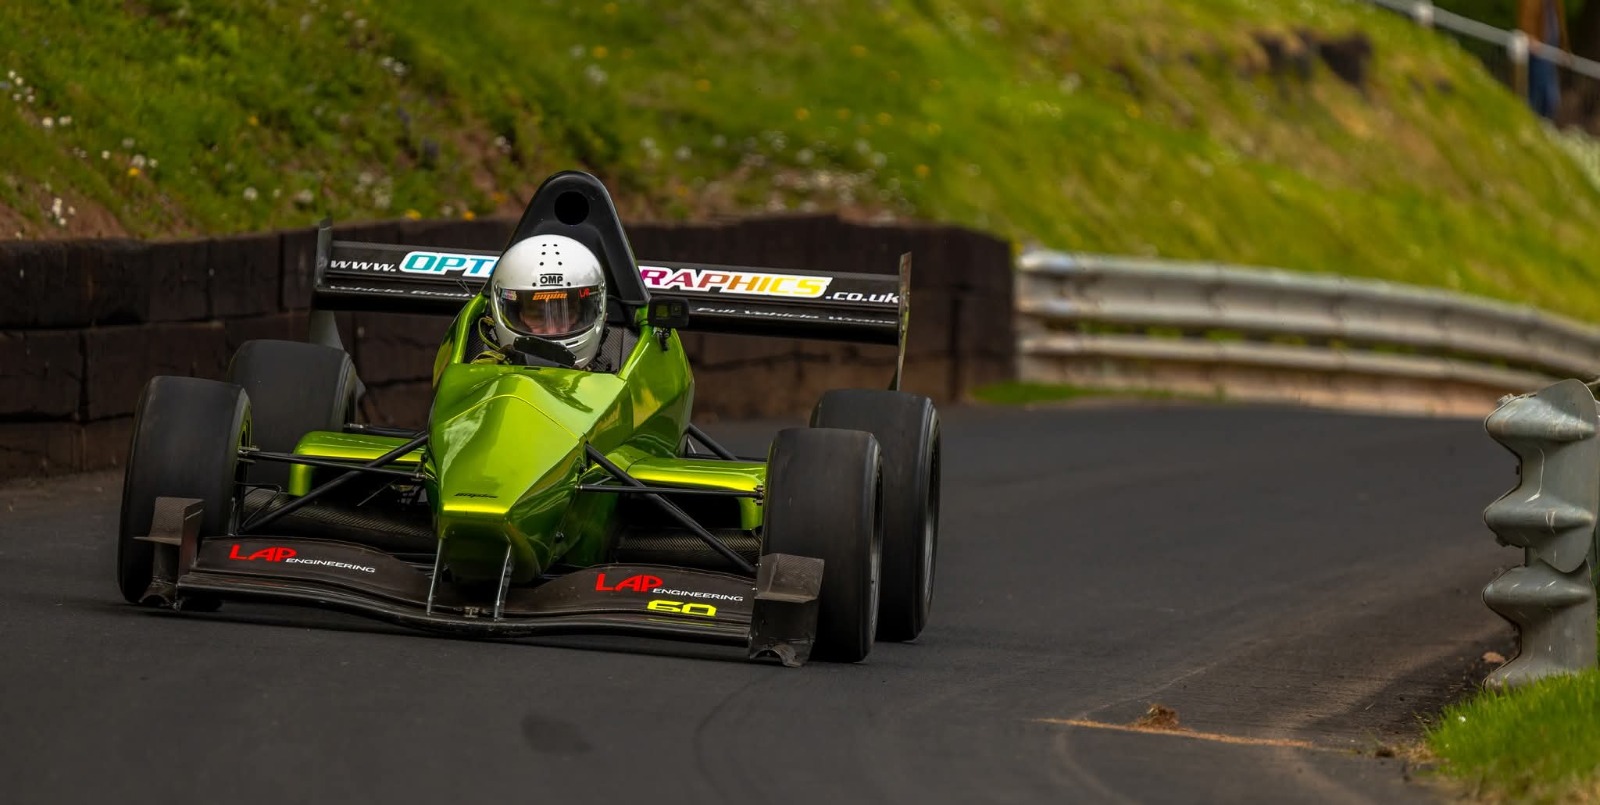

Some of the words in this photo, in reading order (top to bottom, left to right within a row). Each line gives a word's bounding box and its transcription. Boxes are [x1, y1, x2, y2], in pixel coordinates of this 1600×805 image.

[540, 274, 563, 285] OMP
[639, 268, 899, 304] RAPHICS.co.uk
[229, 543, 297, 563] LAP
[285, 557, 376, 574] ENGINEERING
[594, 573, 664, 593] LAP
[652, 587, 744, 602] ENGINEERING
[646, 599, 717, 617] 60
